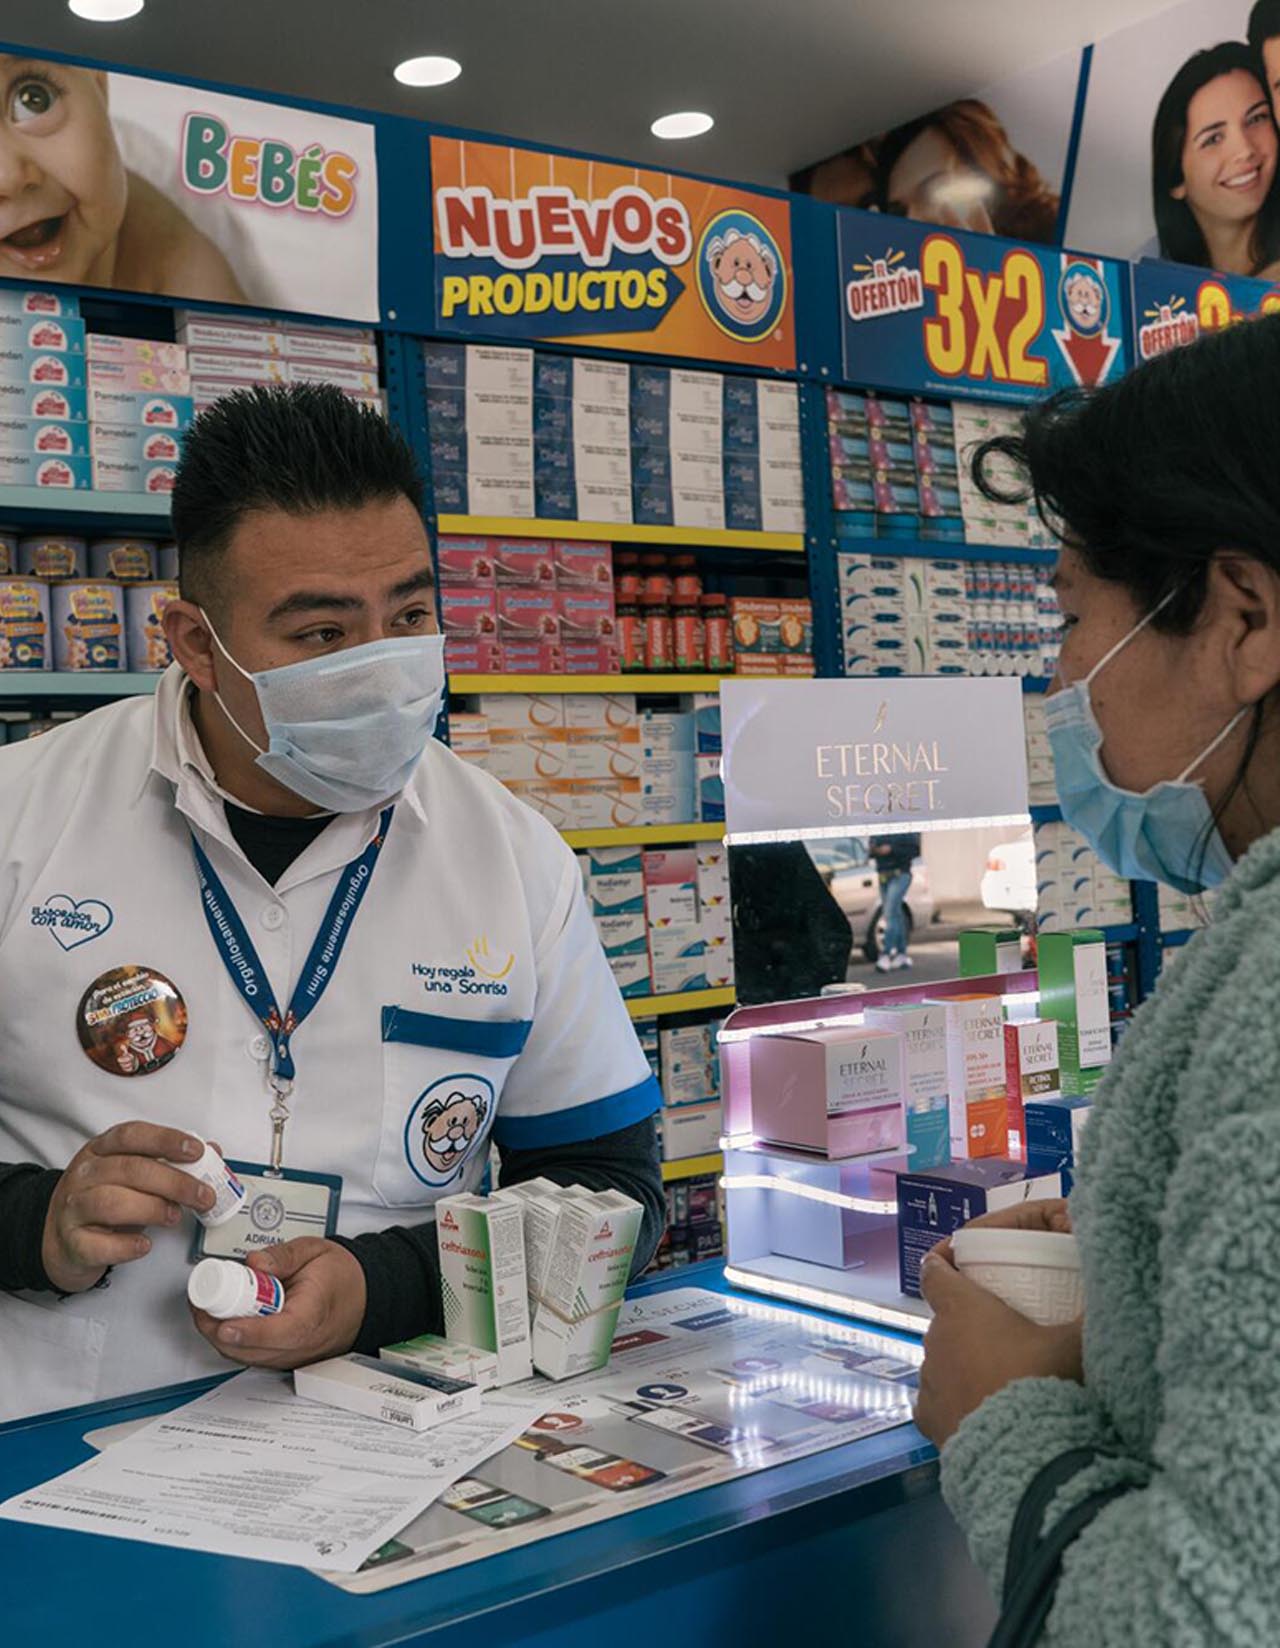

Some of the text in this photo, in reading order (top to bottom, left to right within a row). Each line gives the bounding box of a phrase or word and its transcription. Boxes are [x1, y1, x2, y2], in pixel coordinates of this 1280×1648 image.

[184, 114, 357, 215] BEBÉS
[441, 190, 690, 265] NUEVOS
[441, 267, 669, 317] PRODUCTOS
[850, 270, 921, 315] OFERTÓN
[816, 741, 949, 778] ETERNAL
[827, 779, 941, 817] SECRET
[31, 915, 57, 927] con
[306, 864, 369, 998] Orgullosamente Simi
[204, 889, 258, 996] Orgullosamente
[412, 963, 475, 980] Hoy regala
[425, 979, 508, 995] una Sonrisa
[839, 1059, 887, 1077] ETERNAL
